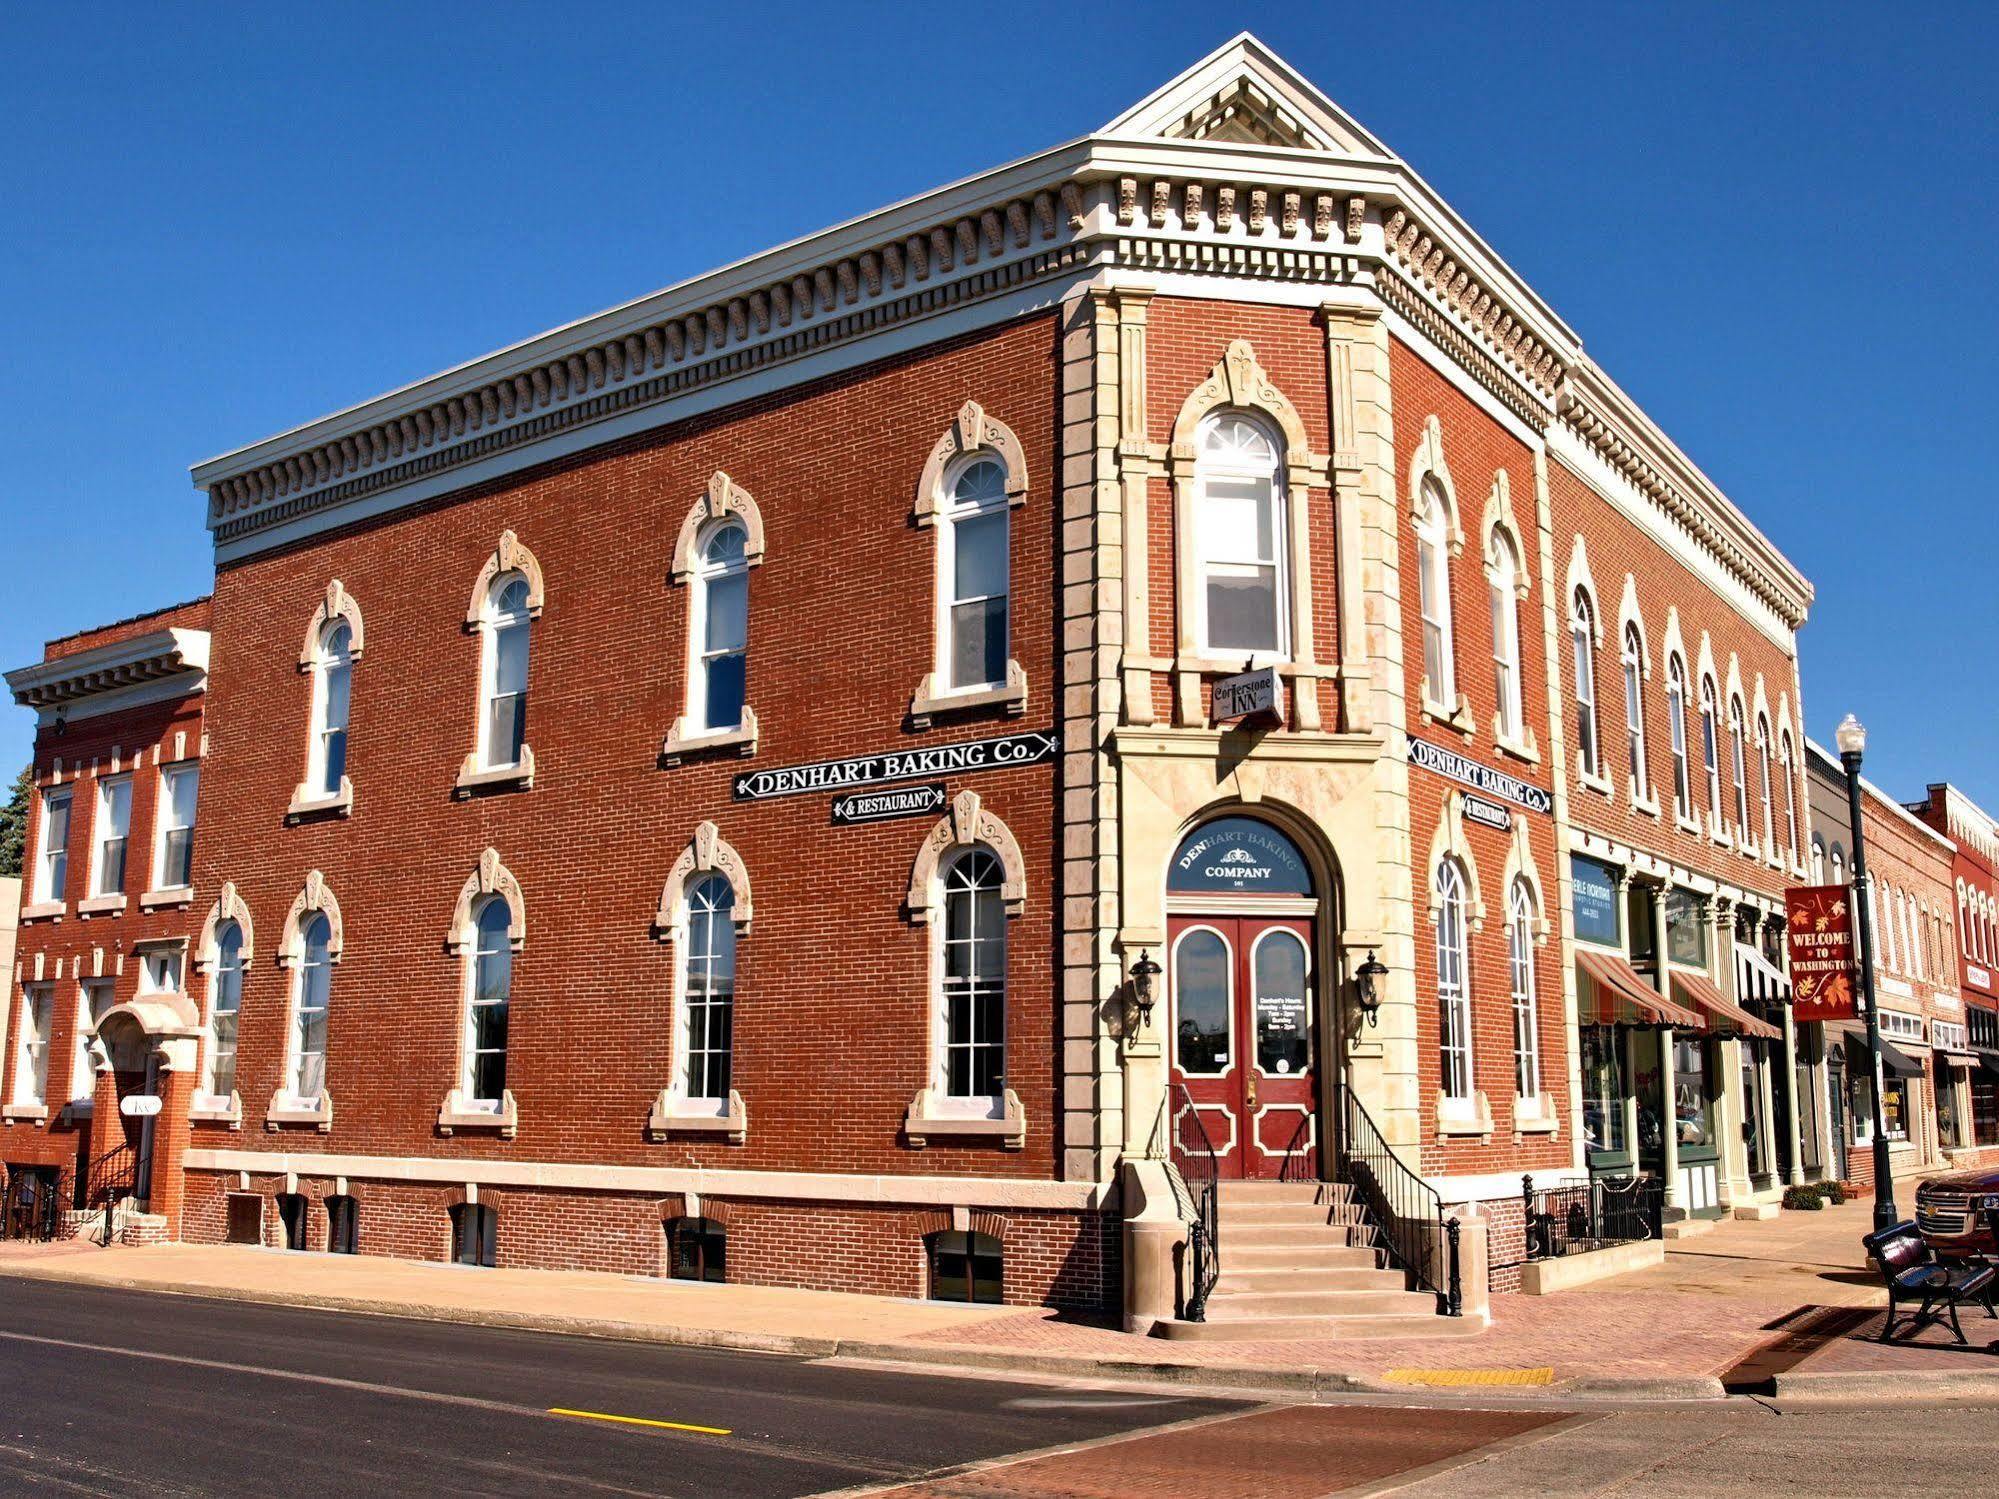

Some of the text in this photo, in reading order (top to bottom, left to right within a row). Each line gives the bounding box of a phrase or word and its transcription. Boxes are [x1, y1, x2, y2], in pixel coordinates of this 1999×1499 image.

[1232, 684, 1257, 714] INN
[757, 740, 1035, 794] DENHART BAKING Co.
[1417, 743, 1543, 810] DENHART BAKING Co.
[846, 791, 932, 815] & RESTAURANT
[1472, 801, 1505, 825] RESTAURANT
[1179, 832, 1297, 870] DENHART BAKING
[1205, 867, 1271, 878] COMPANY
[1792, 931, 1850, 947] WELCOME
[1815, 948, 1829, 958] TO
[1792, 960, 1853, 972] WASHINGTON
